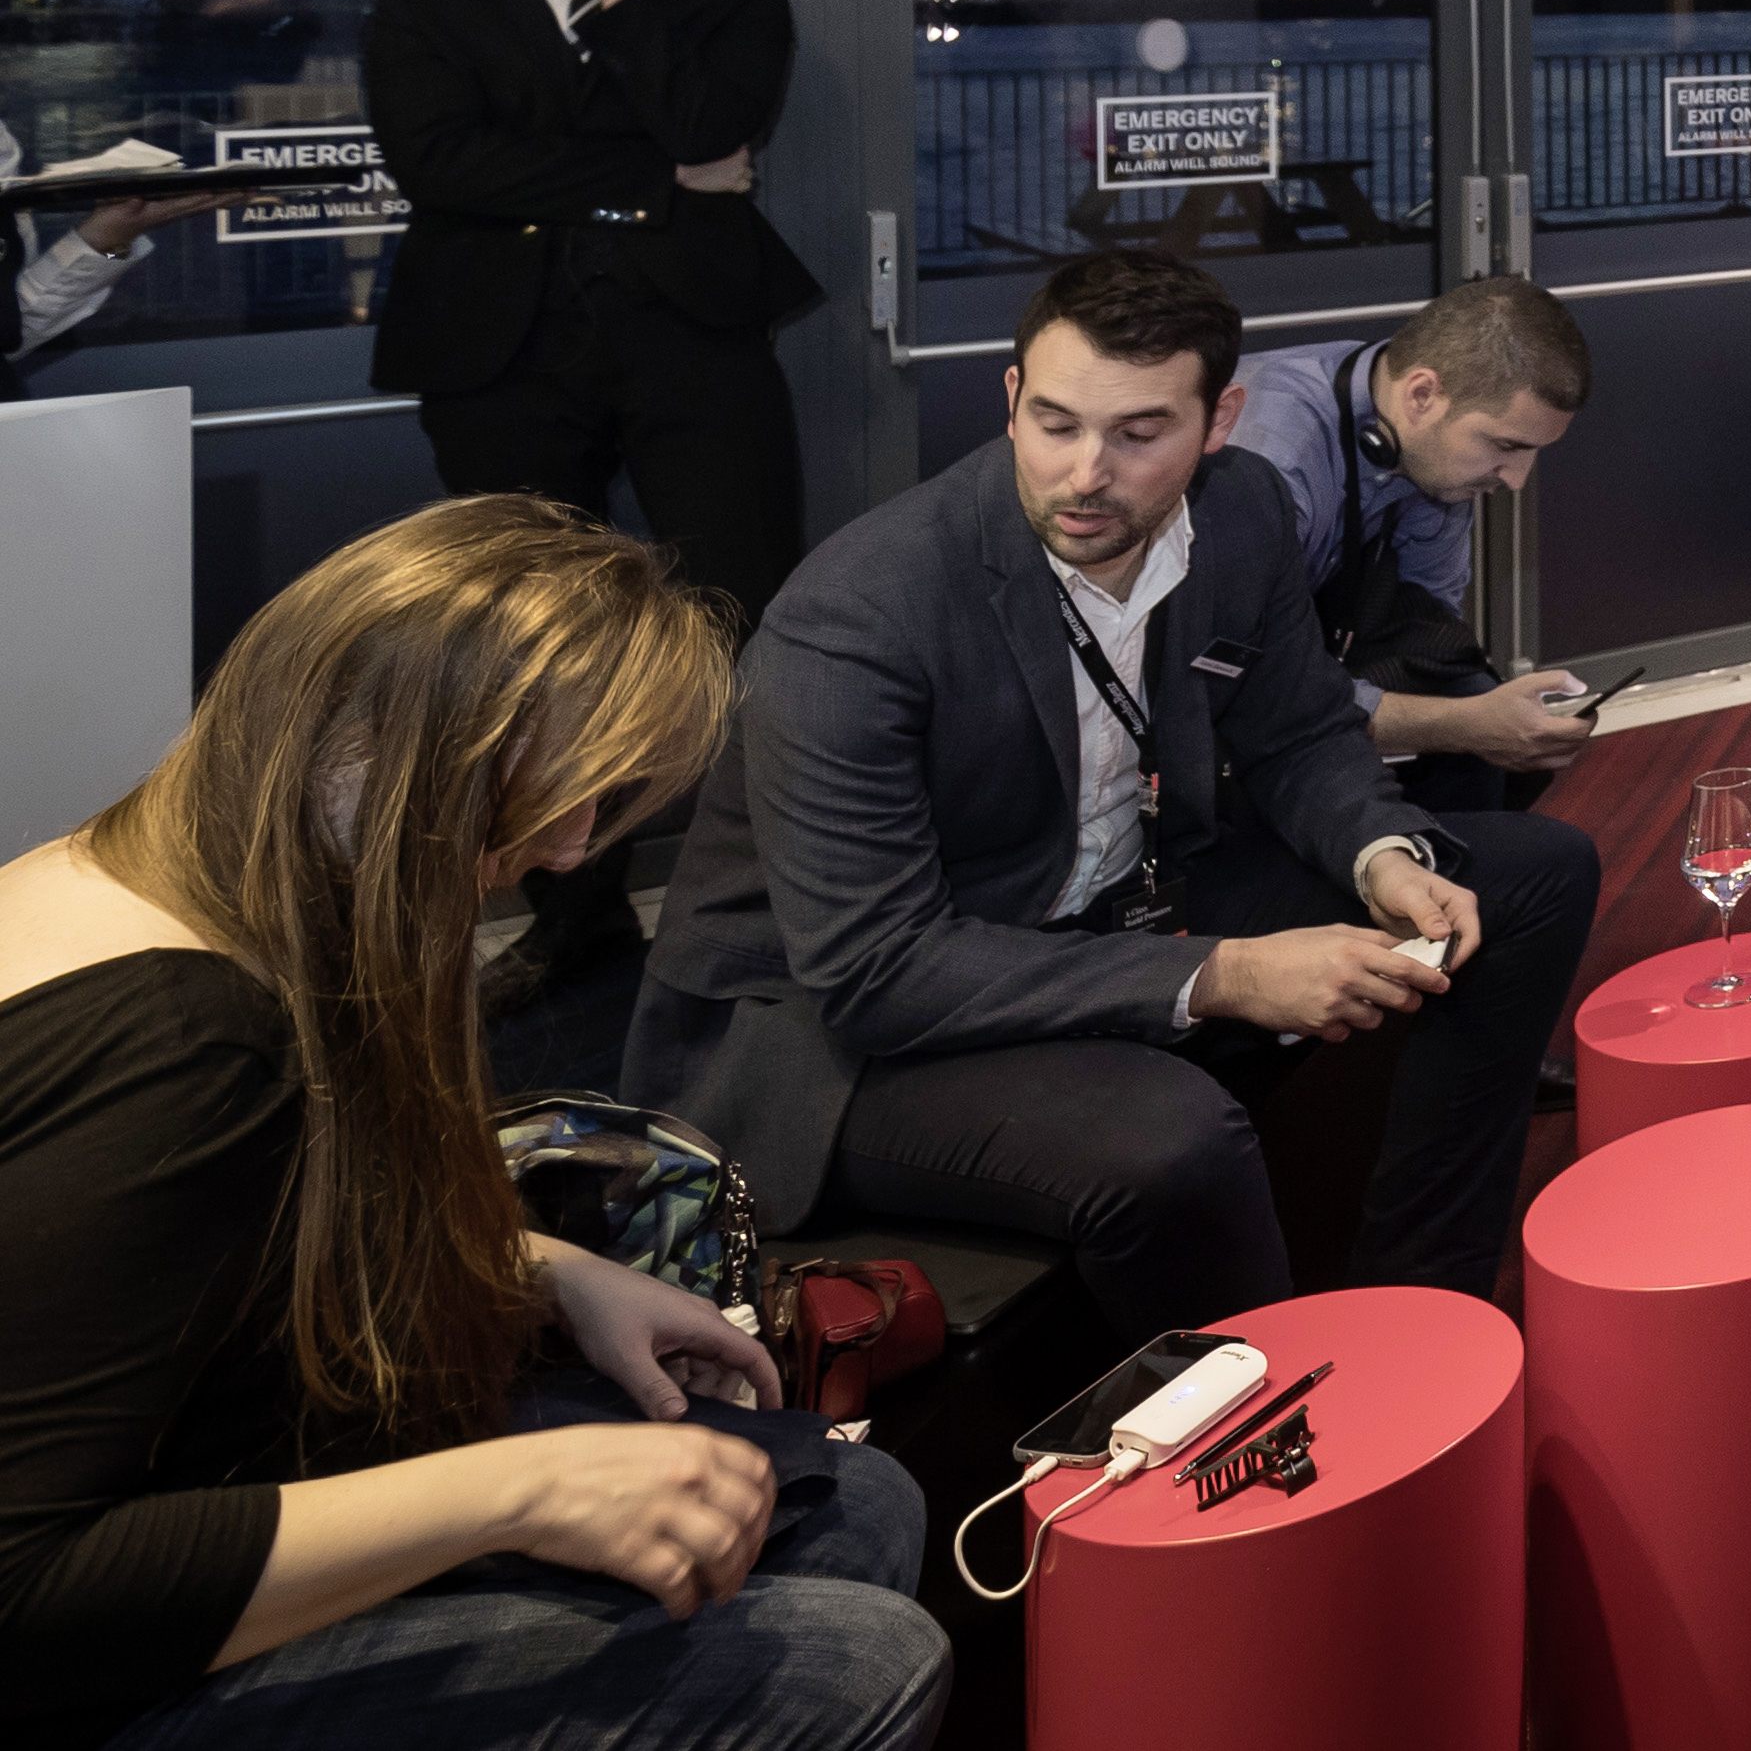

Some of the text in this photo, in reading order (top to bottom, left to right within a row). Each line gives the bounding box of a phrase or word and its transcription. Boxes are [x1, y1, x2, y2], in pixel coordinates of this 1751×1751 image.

[1114, 107, 1259, 130] EMERGENCY
[1688, 108, 1726, 124] EXIT
[1128, 130, 1249, 153] EXIT ONLY
[1678, 131, 1717, 142] ALARM
[1719, 129, 1744, 140] WILL
[242, 142, 386, 168] EMERGE
[1114, 154, 1262, 174] ALARM WILL SOUND
[242, 203, 320, 223] ALARM
[323, 201, 379, 218] WILL
[1056, 587, 1092, 648] Mercedes
